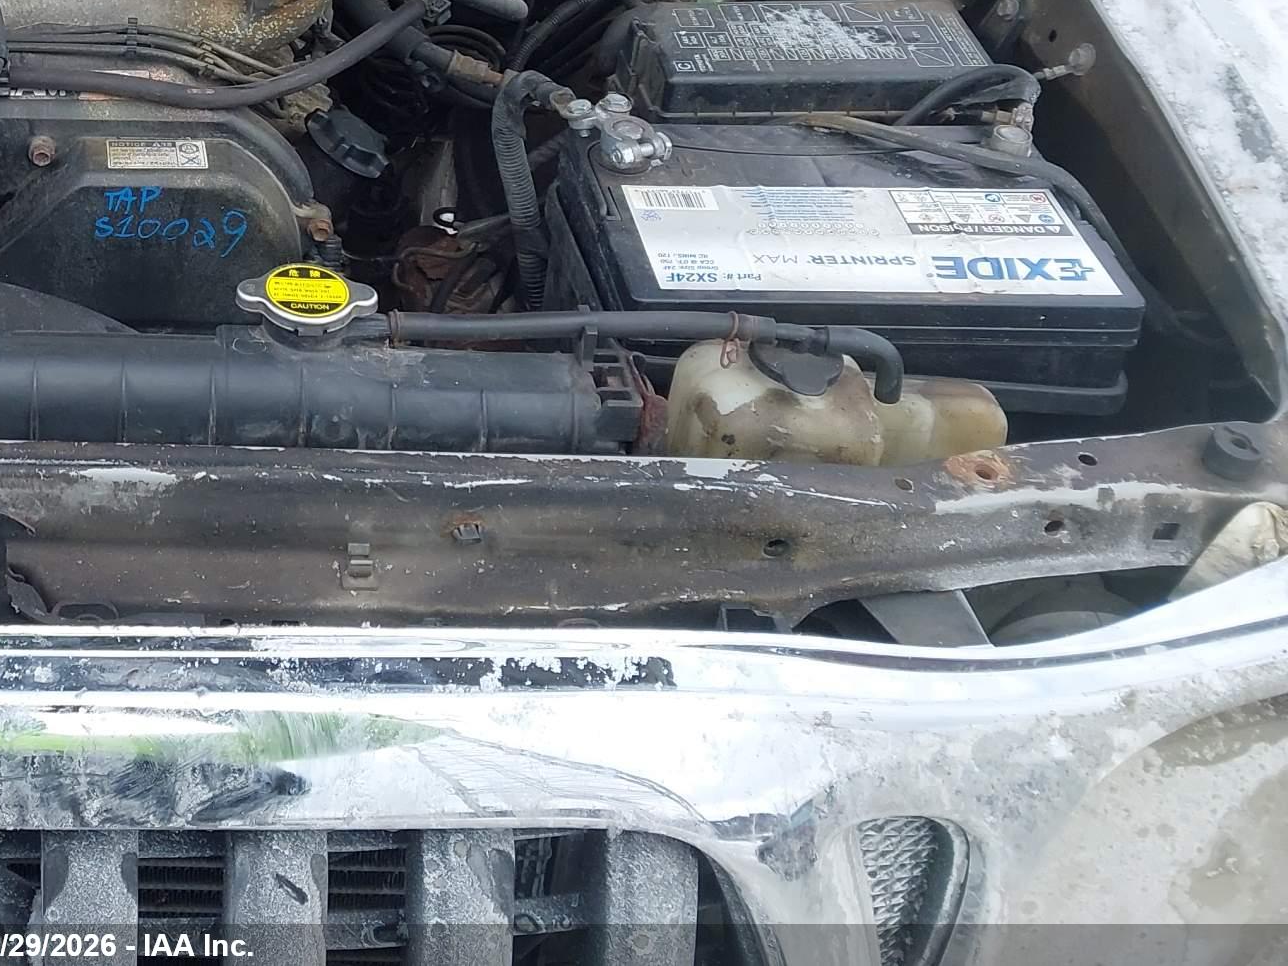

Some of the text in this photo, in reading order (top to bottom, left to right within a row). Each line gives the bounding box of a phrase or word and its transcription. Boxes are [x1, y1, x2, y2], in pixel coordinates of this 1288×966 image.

[104, 186, 165, 213] TAP
[983, 224, 1045, 234] DANGER
[752, 254, 798, 265] MAX
[931, 256, 1094, 281] EXIDE
[665, 272, 718, 283] SX24F
[737, 273, 761, 282] Part
[290, 302, 330, 310] CAUTION
